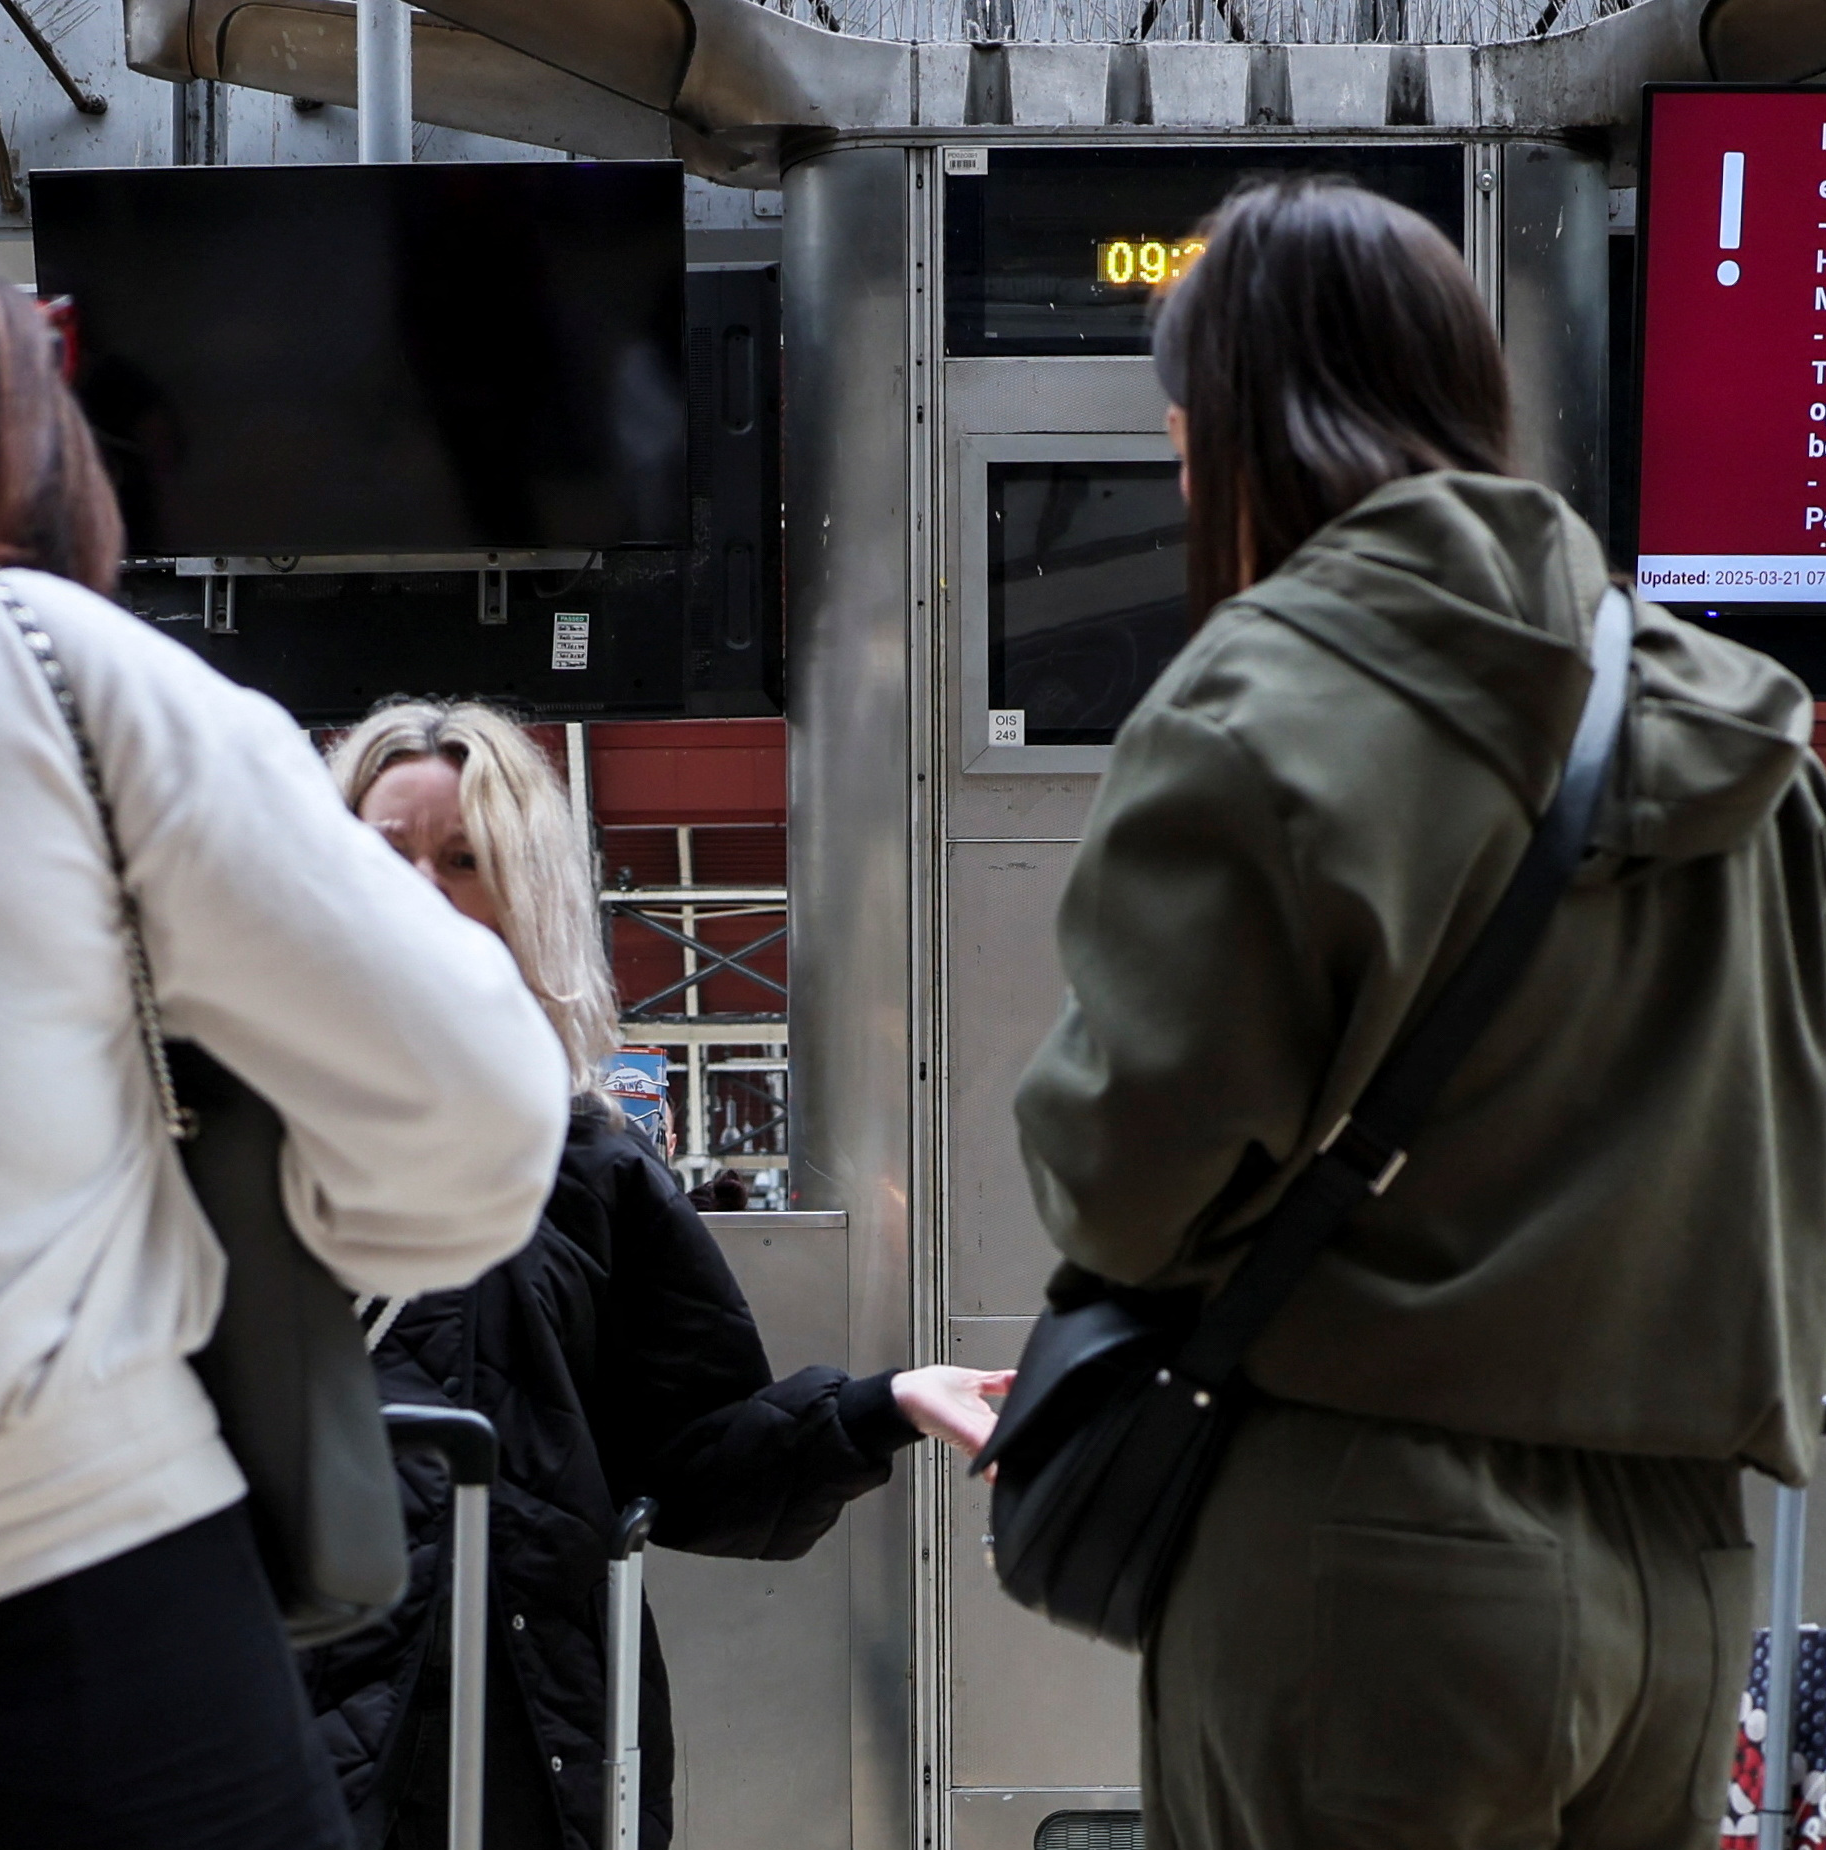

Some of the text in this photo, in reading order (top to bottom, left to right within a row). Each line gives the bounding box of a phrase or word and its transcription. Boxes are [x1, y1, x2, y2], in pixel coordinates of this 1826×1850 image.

[1641, 570, 1710, 589] Updated:
[1715, 570, 1800, 586] 2025-03-21
[995, 715, 1017, 726] OIS
[995, 730, 1017, 741] 249
